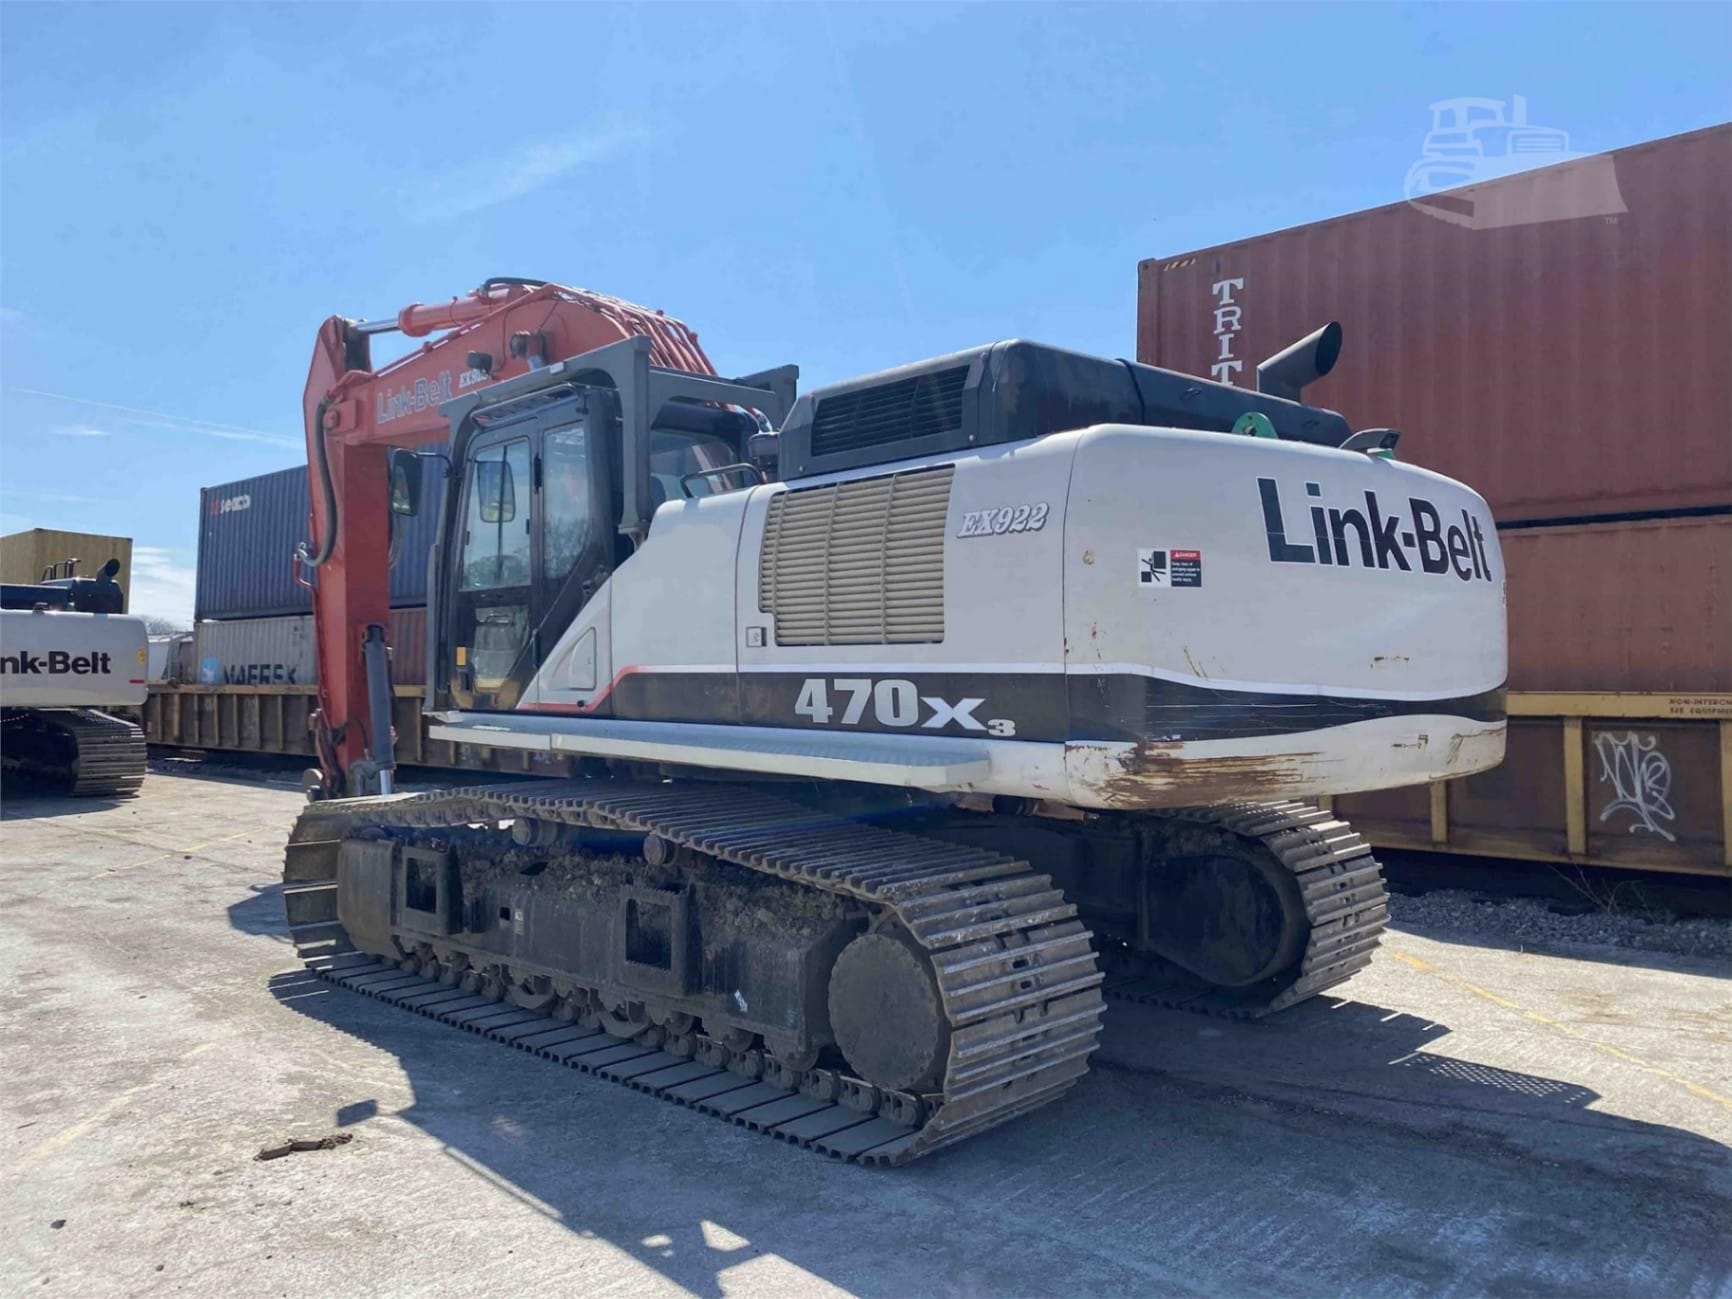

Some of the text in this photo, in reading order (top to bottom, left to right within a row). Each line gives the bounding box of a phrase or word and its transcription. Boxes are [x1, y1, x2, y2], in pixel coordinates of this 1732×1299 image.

[1211, 278, 1244, 386] TRIT
[376, 370, 452, 424] Link-Belt
[957, 502, 1049, 539] EX922
[1257, 477, 1492, 581] Link-Belt
